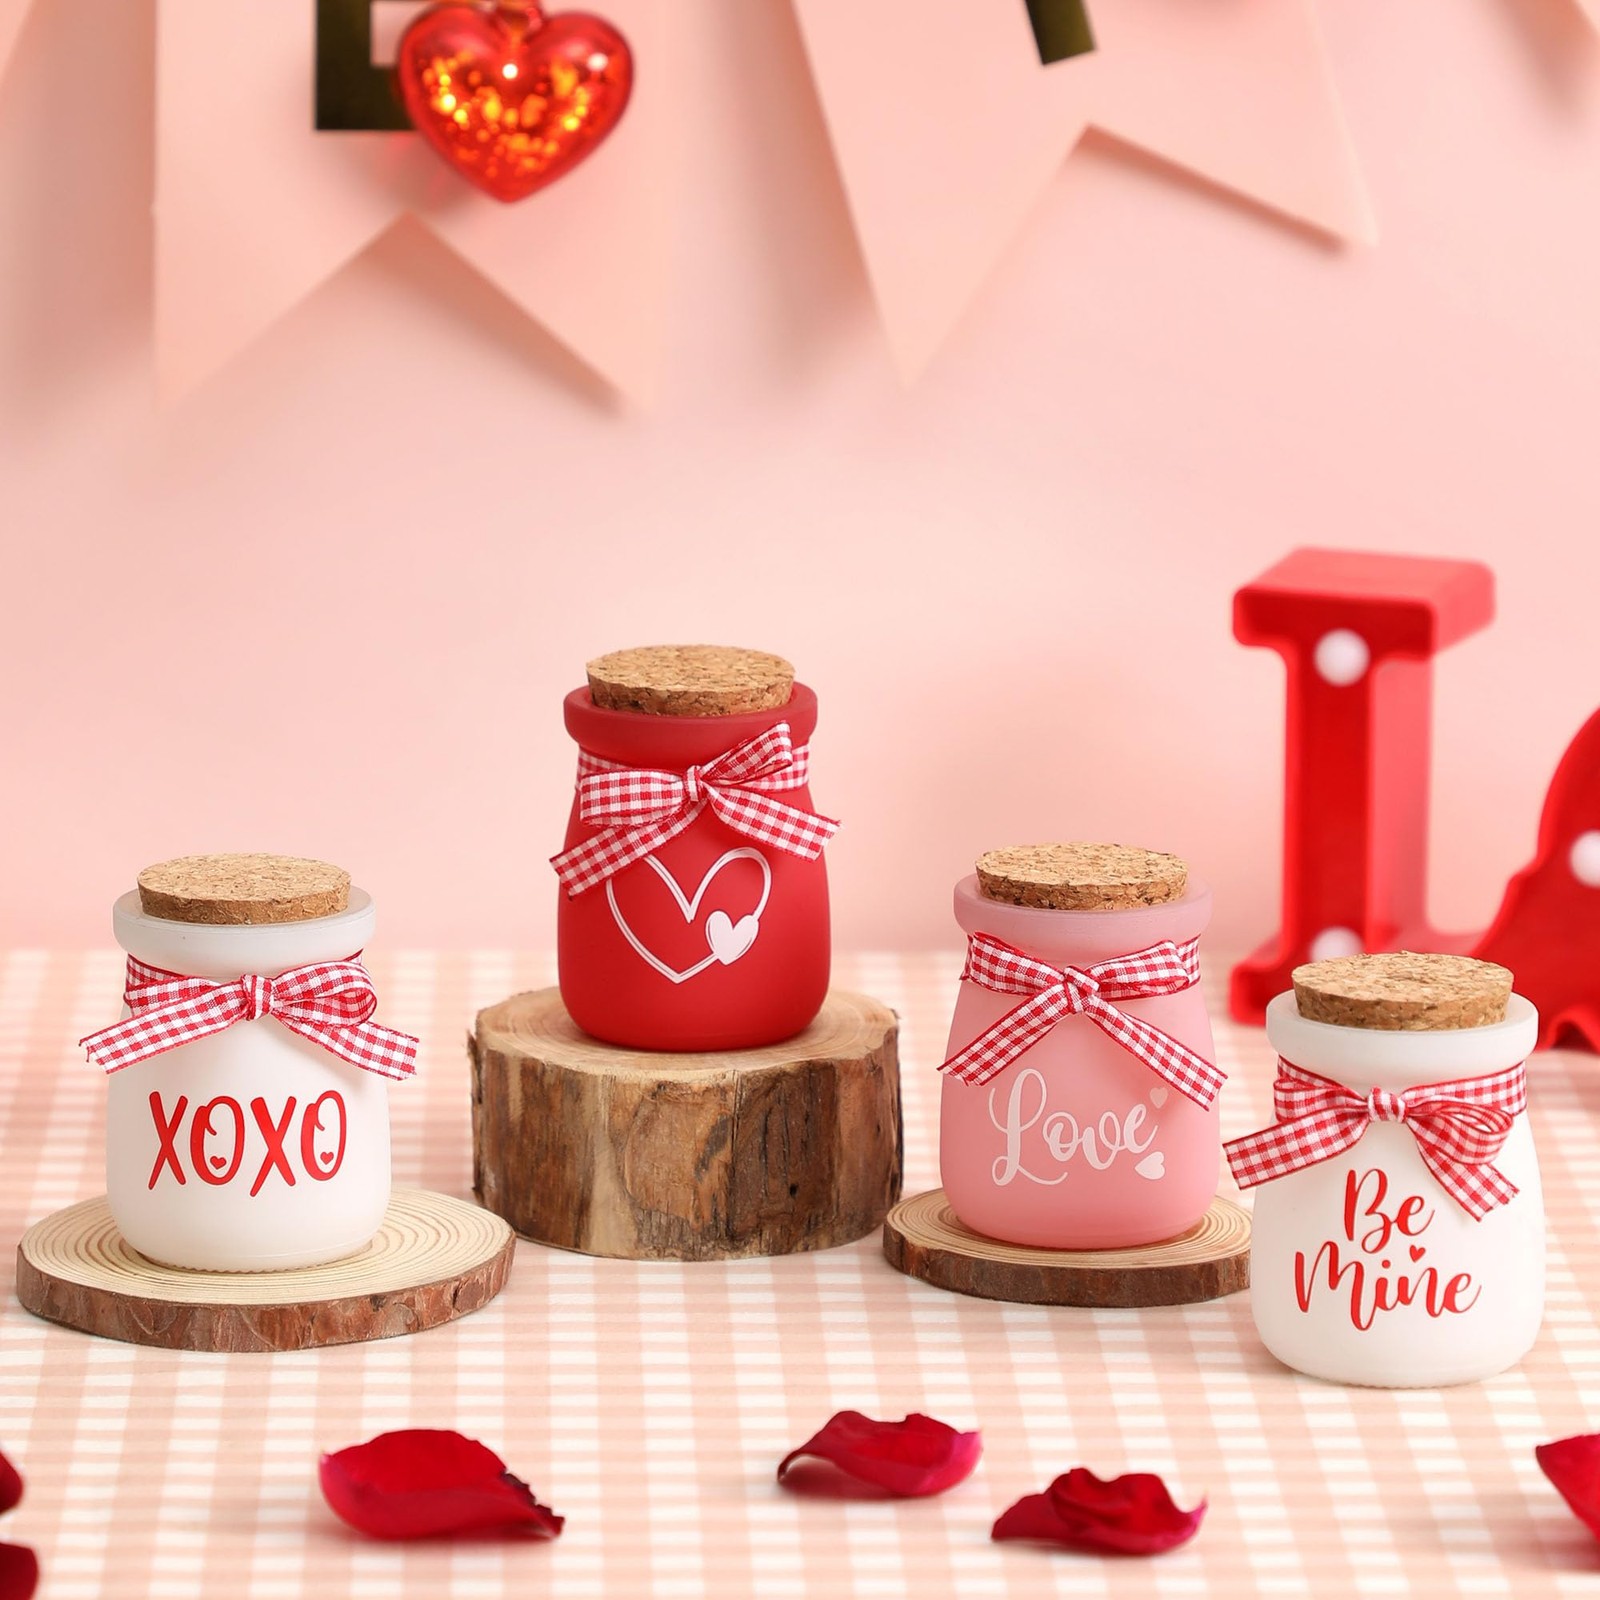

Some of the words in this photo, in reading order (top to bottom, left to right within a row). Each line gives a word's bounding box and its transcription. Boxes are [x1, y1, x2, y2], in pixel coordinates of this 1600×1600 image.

[148, 1089, 347, 1197] XOXO
[988, 1068, 1159, 1186] Love
[1343, 1168, 1435, 1254] Be
[1294, 1241, 1482, 1331] Mine
